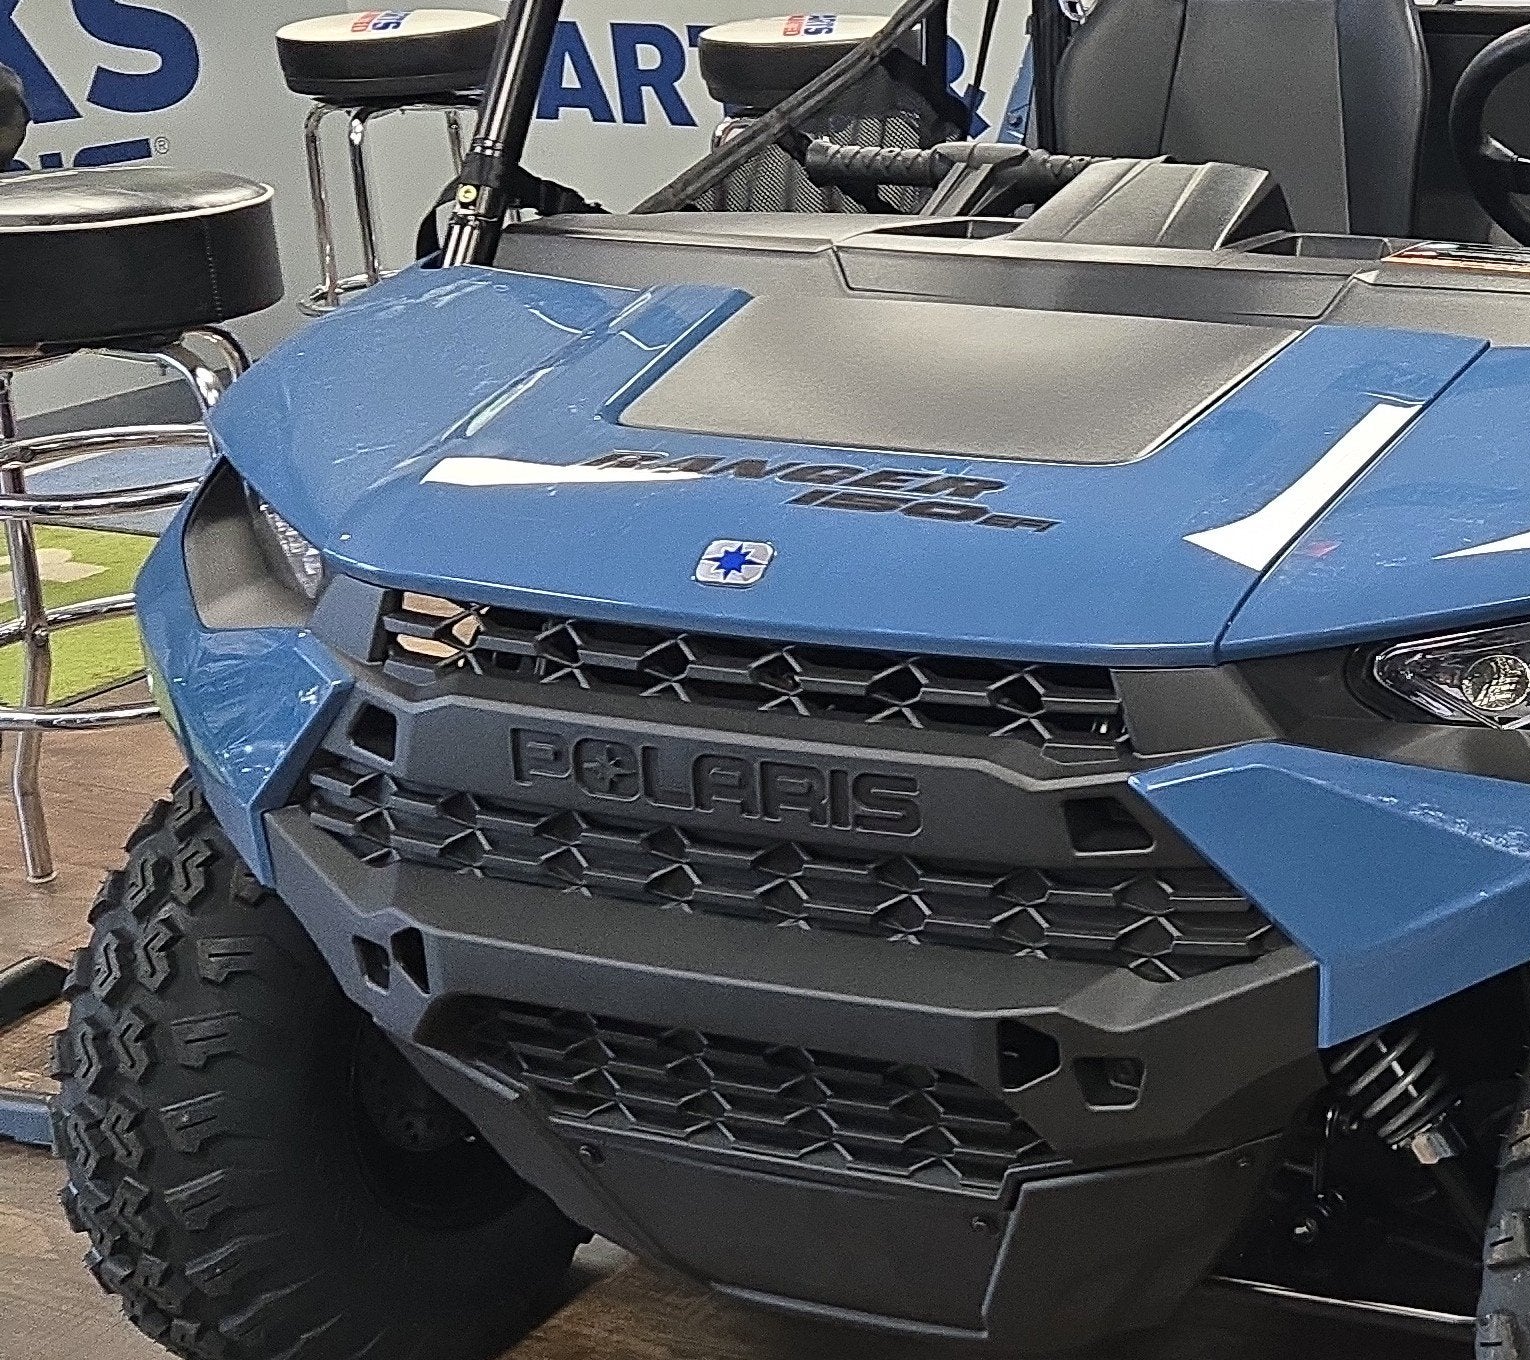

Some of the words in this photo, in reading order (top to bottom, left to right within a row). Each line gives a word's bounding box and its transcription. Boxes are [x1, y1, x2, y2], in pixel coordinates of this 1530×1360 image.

[585, 448, 1009, 500] RANGER
[779, 488, 990, 523] 150
[510, 727, 924, 837] POLARIS
